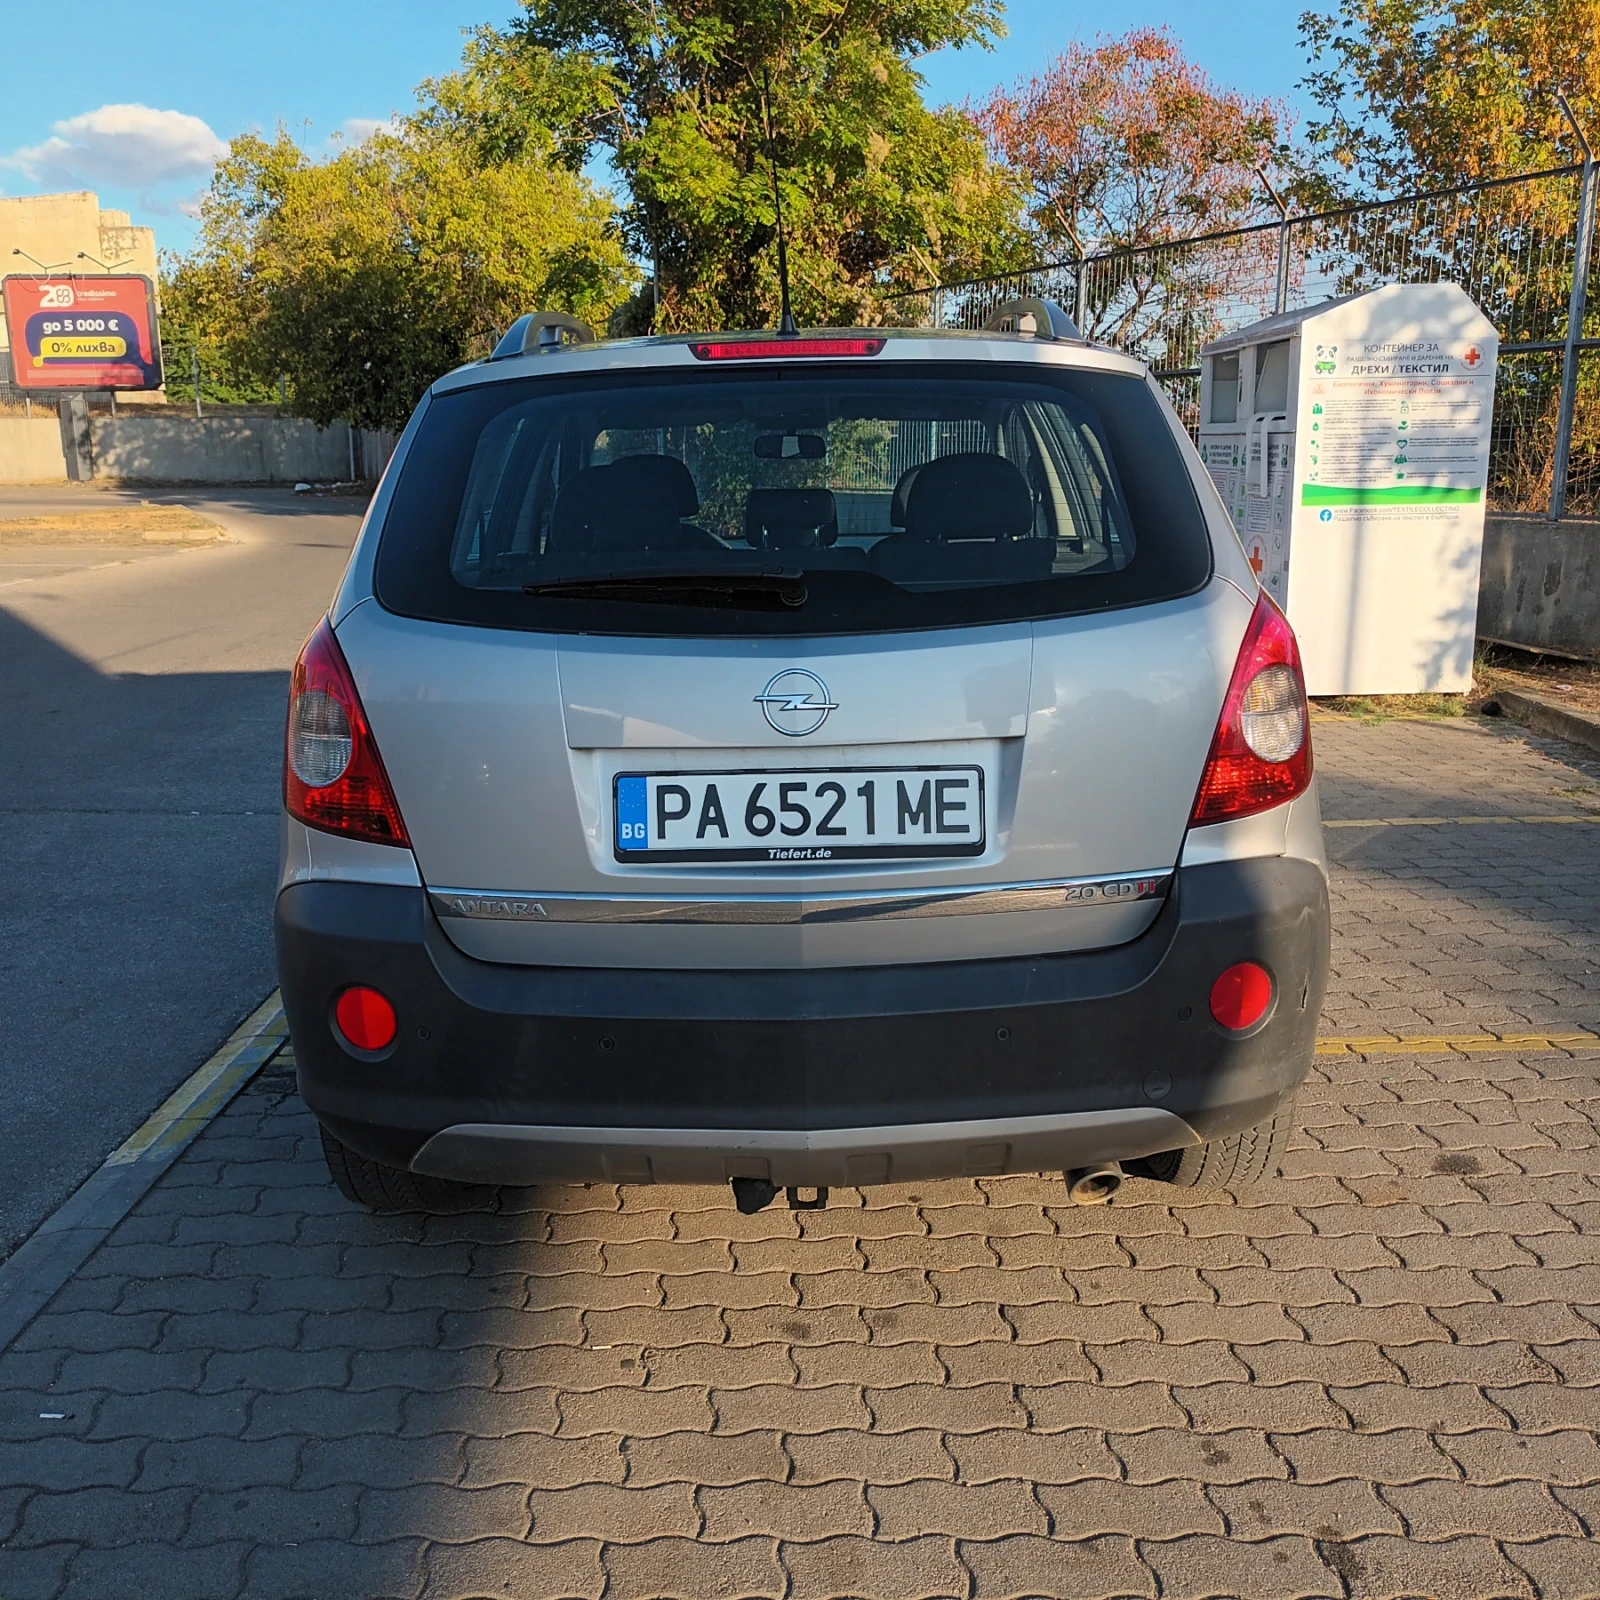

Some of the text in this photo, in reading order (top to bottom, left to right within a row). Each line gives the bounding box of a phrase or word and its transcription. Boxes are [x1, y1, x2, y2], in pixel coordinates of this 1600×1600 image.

[64, 320, 73, 331] 5
[76, 319, 105, 331] 000
[108, 319, 119, 331] €
[51, 342, 116, 353] 0% лихва
[1364, 343, 1439, 353] КОНТЕЙНЕР ЗА
[1351, 365, 1389, 375] ДРЕХИ
[1398, 364, 1449, 373] ТЕКСТИЛ
[656, 778, 970, 839] PA 6521 ME
[621, 823, 646, 839] BG
[768, 848, 832, 860] Tiefert.de
[1102, 880, 1156, 897] CDTI
[451, 899, 547, 917] ANTARA
